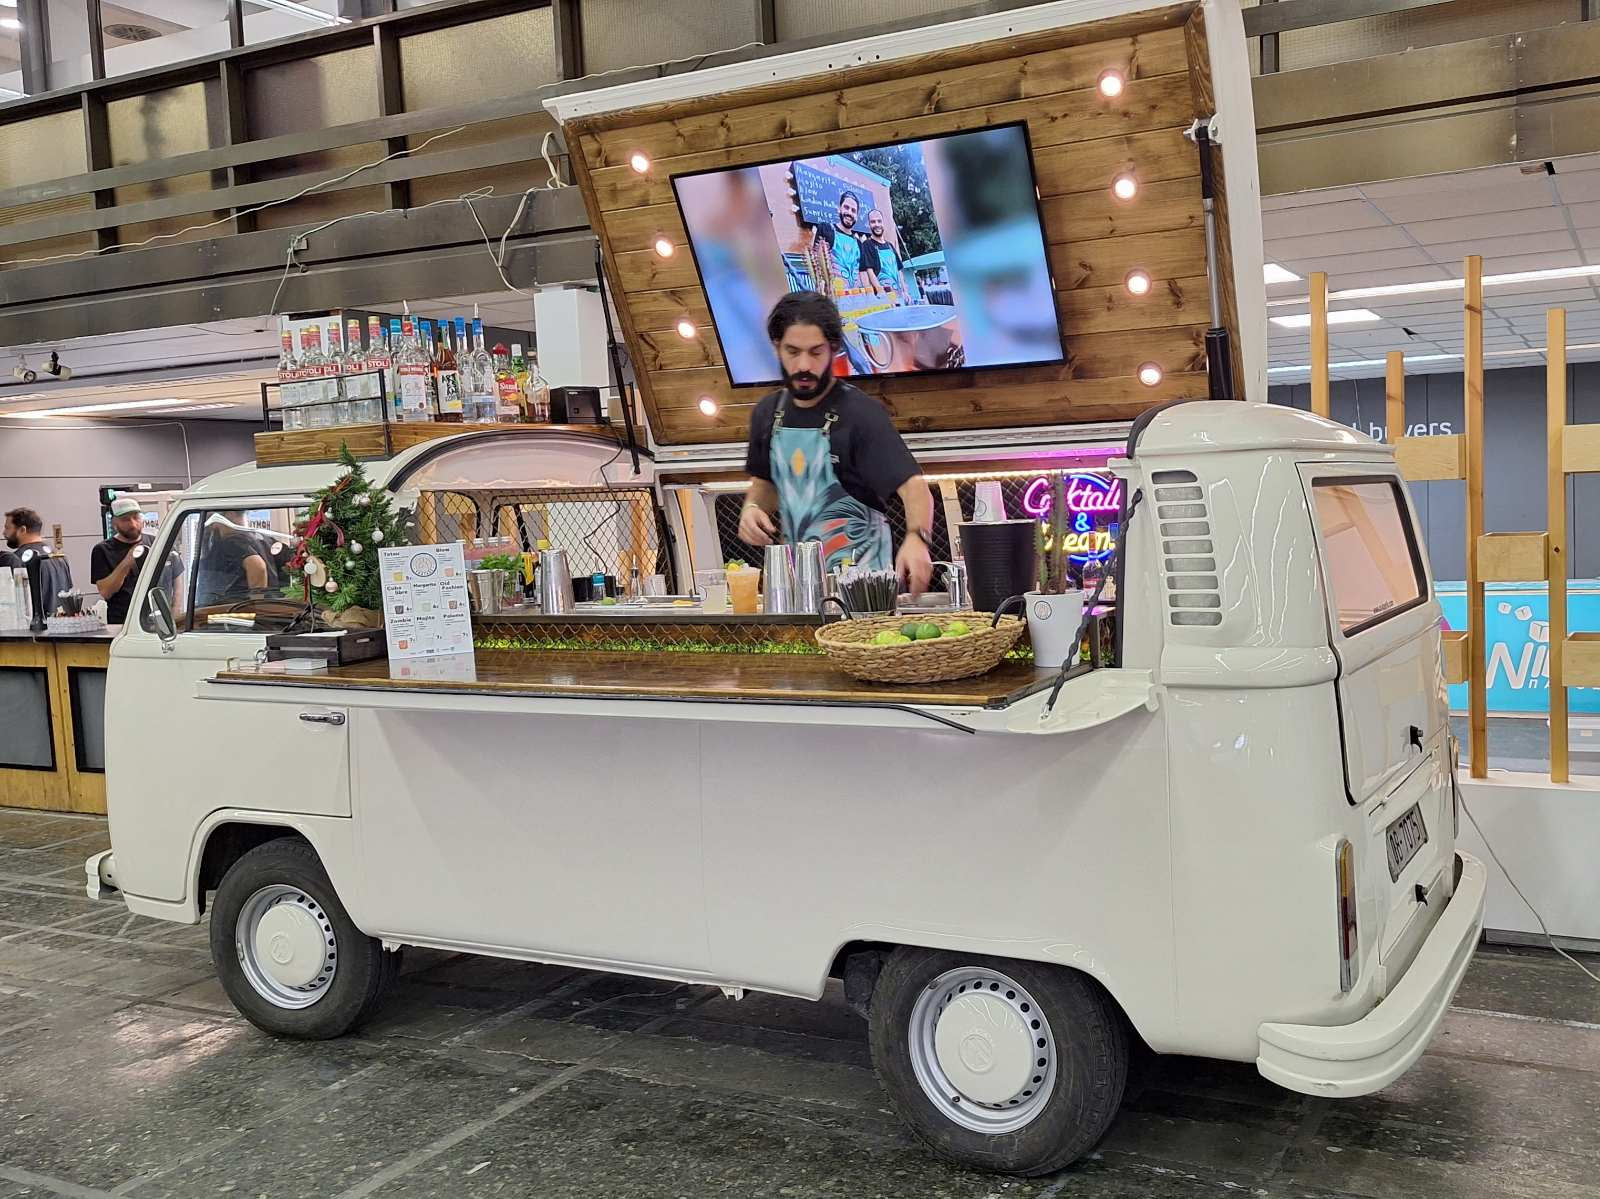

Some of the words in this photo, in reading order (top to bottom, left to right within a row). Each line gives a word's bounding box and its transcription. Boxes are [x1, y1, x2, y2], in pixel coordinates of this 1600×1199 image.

[368, 359, 389, 368] STOLI
[1369, 421, 1452, 442] byers
[1075, 512, 1091, 531] &
